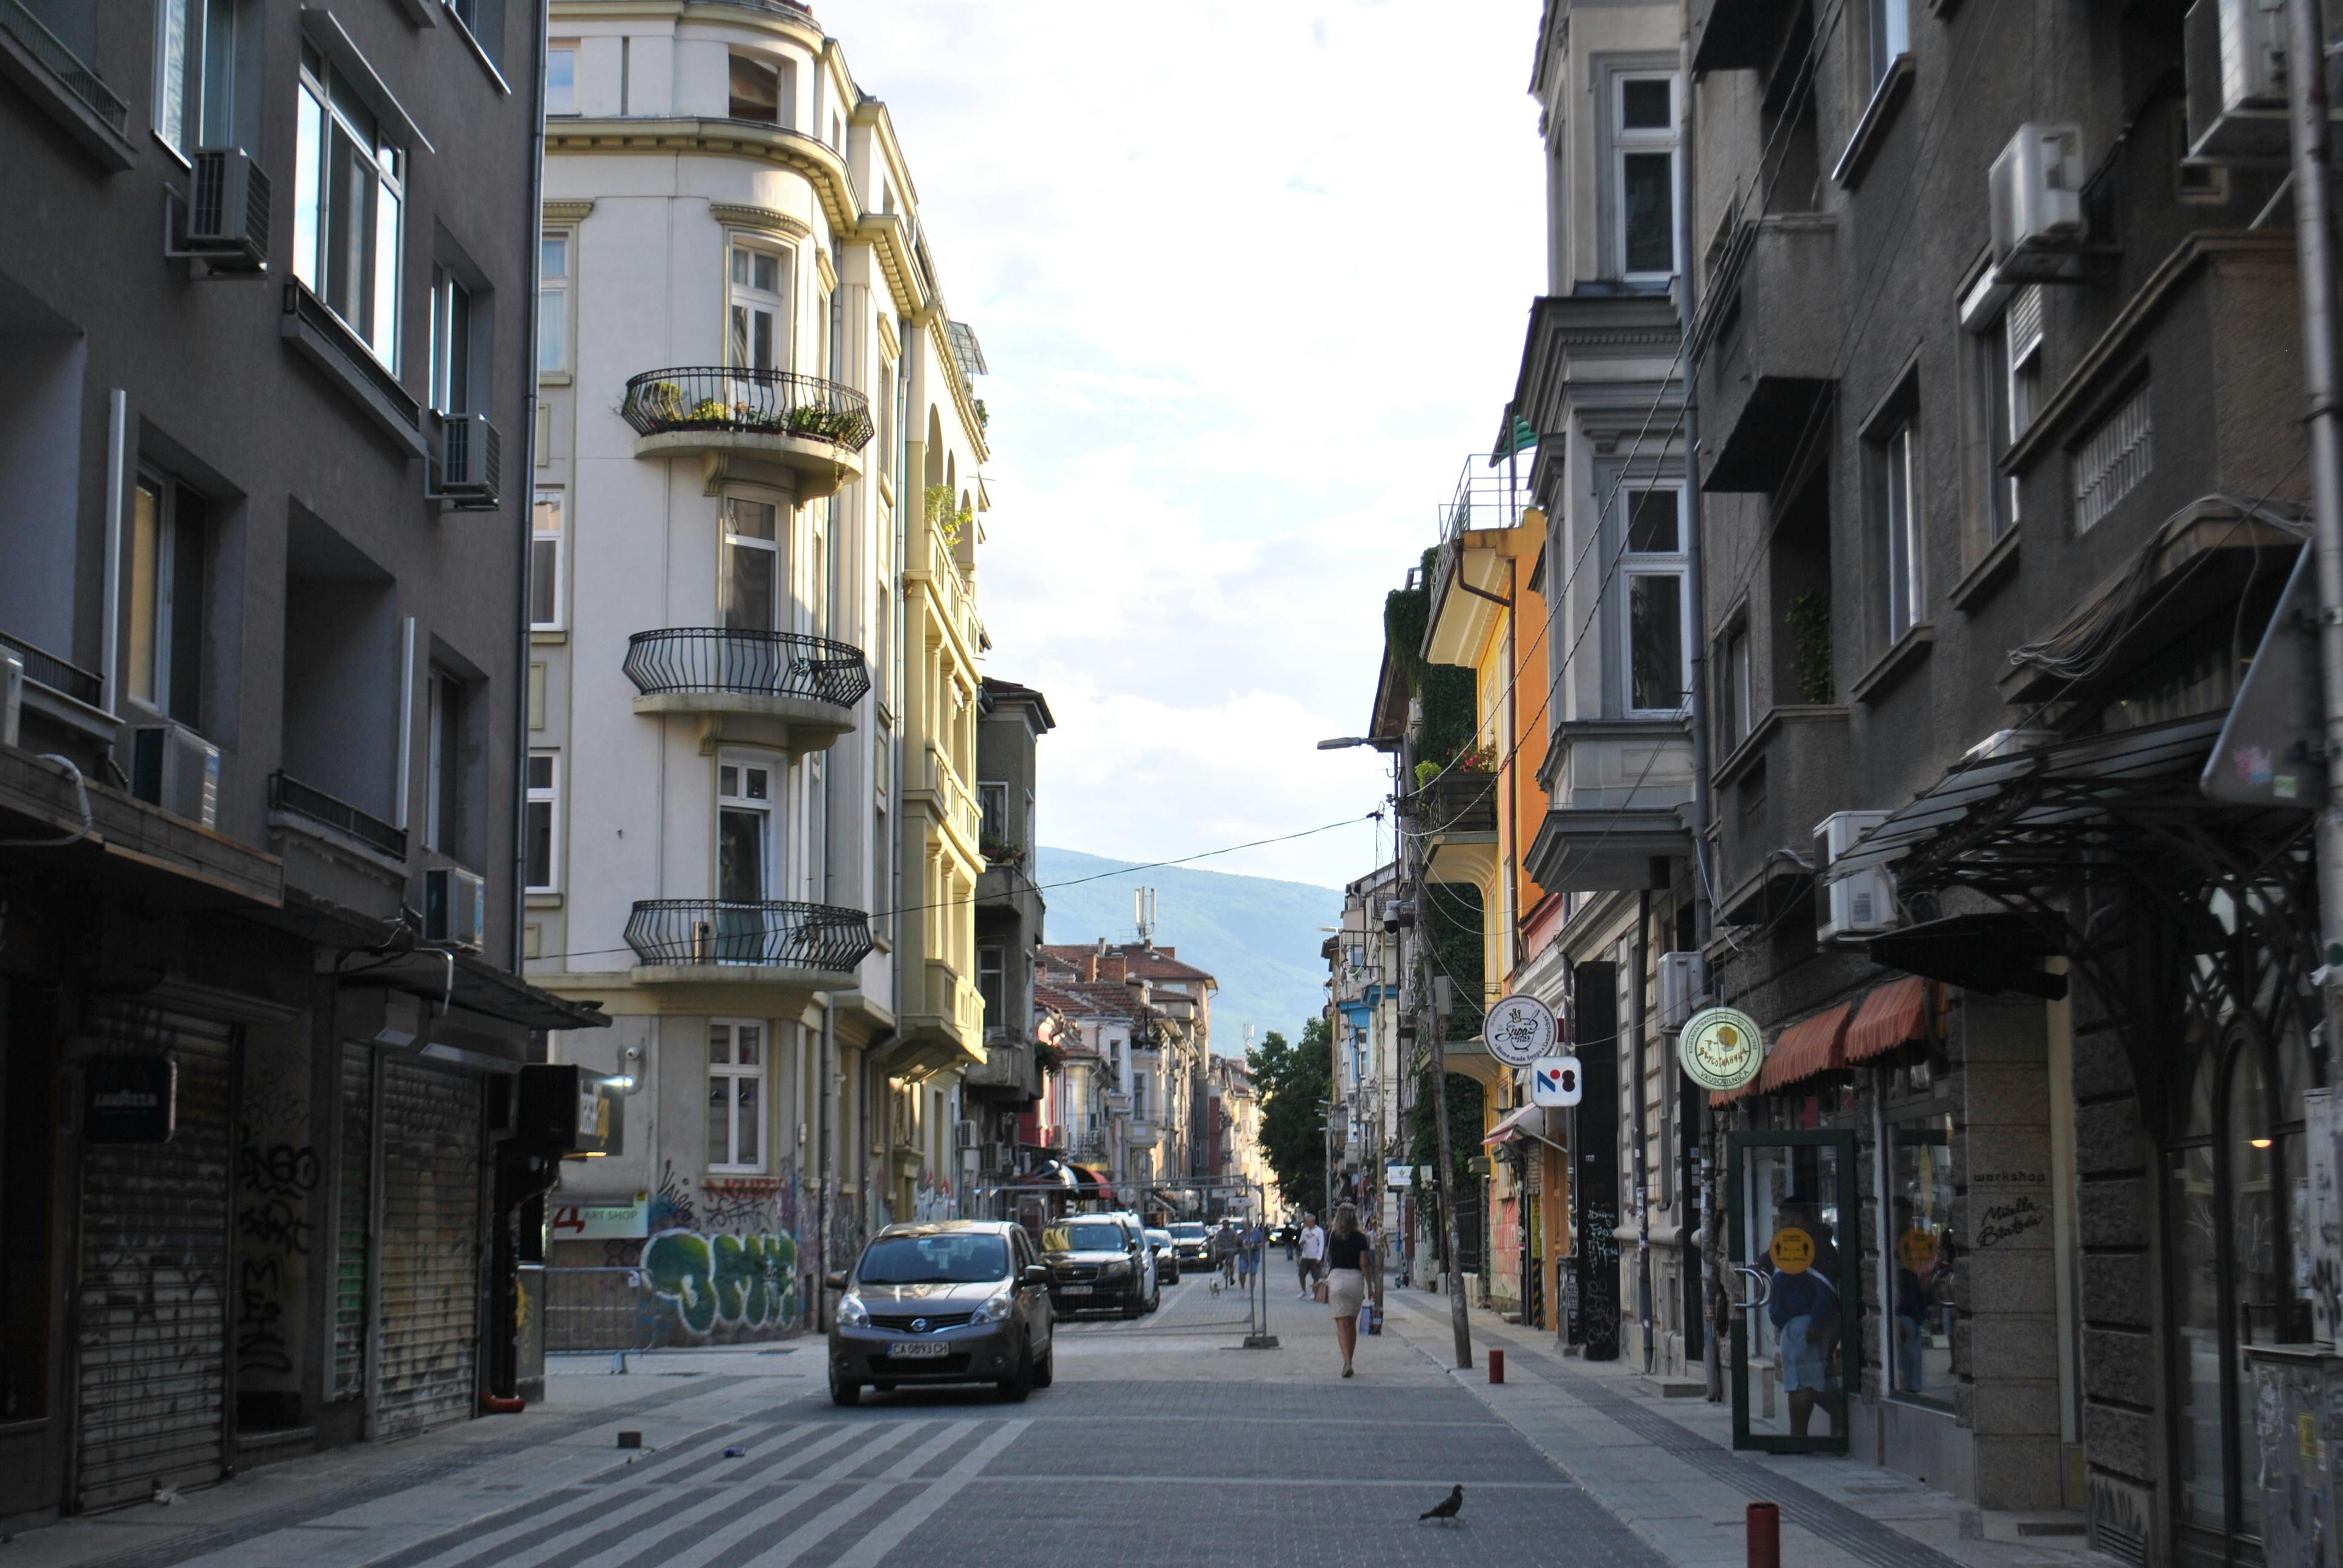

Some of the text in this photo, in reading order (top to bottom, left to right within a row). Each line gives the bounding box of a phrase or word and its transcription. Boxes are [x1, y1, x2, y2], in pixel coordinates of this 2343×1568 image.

[1688, 1025, 1701, 1054] BULGARIAN
[1699, 1014, 1729, 1028] TRADITIONAL
[1527, 1050, 1542, 1061] Soups
[1974, 1171, 2046, 1183] workshop
[583, 1210, 638, 1220] ART SHOP
[894, 1343, 906, 1354] CA
